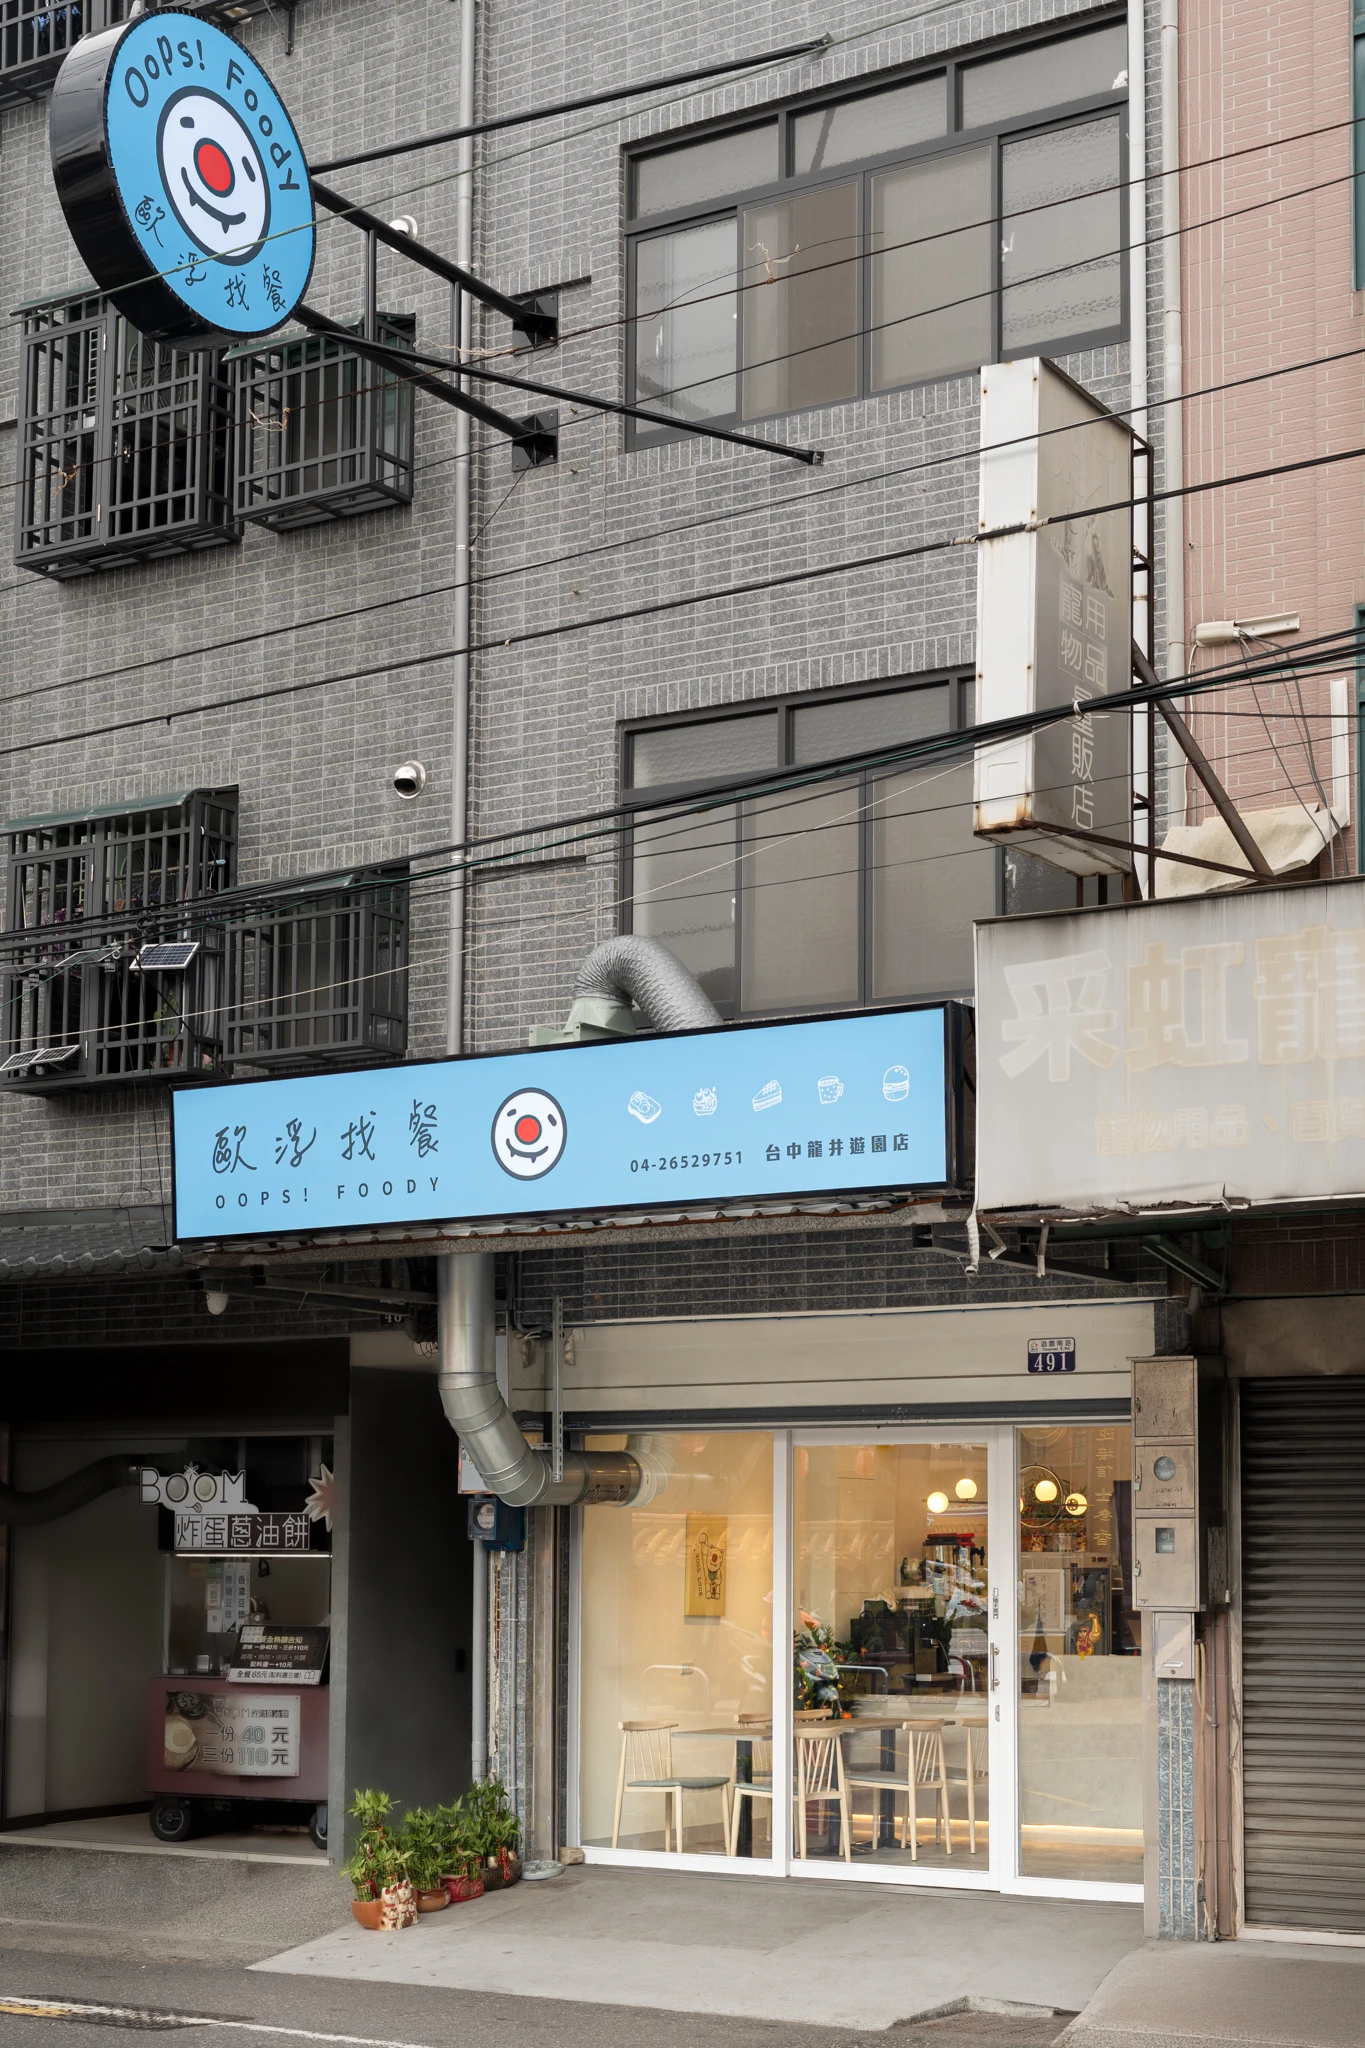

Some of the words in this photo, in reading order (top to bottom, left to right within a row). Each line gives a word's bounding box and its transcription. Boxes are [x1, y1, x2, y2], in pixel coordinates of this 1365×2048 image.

[124, 35, 205, 108] Oops!
[212, 1099, 439, 1174] 歐浮找餐
[765, 1133, 909, 1162] 台中龍井遊園店
[630, 1151, 743, 1173] 04-26529751
[215, 1187, 308, 1210] OOPS!
[337, 1177, 439, 1200] FOODY
[1034, 1352, 1067, 1371] 491
[141, 1467, 248, 1504] BOOM
[177, 1514, 309, 1549] 炸蛋蔥油餅
[205, 1726, 235, 1742] 一份
[241, 1725, 265, 1744] 40
[272, 1727, 289, 1743] 元
[202, 1746, 235, 1765] 三份
[238, 1747, 268, 1766] 110
[271, 1748, 289, 1765] 元
